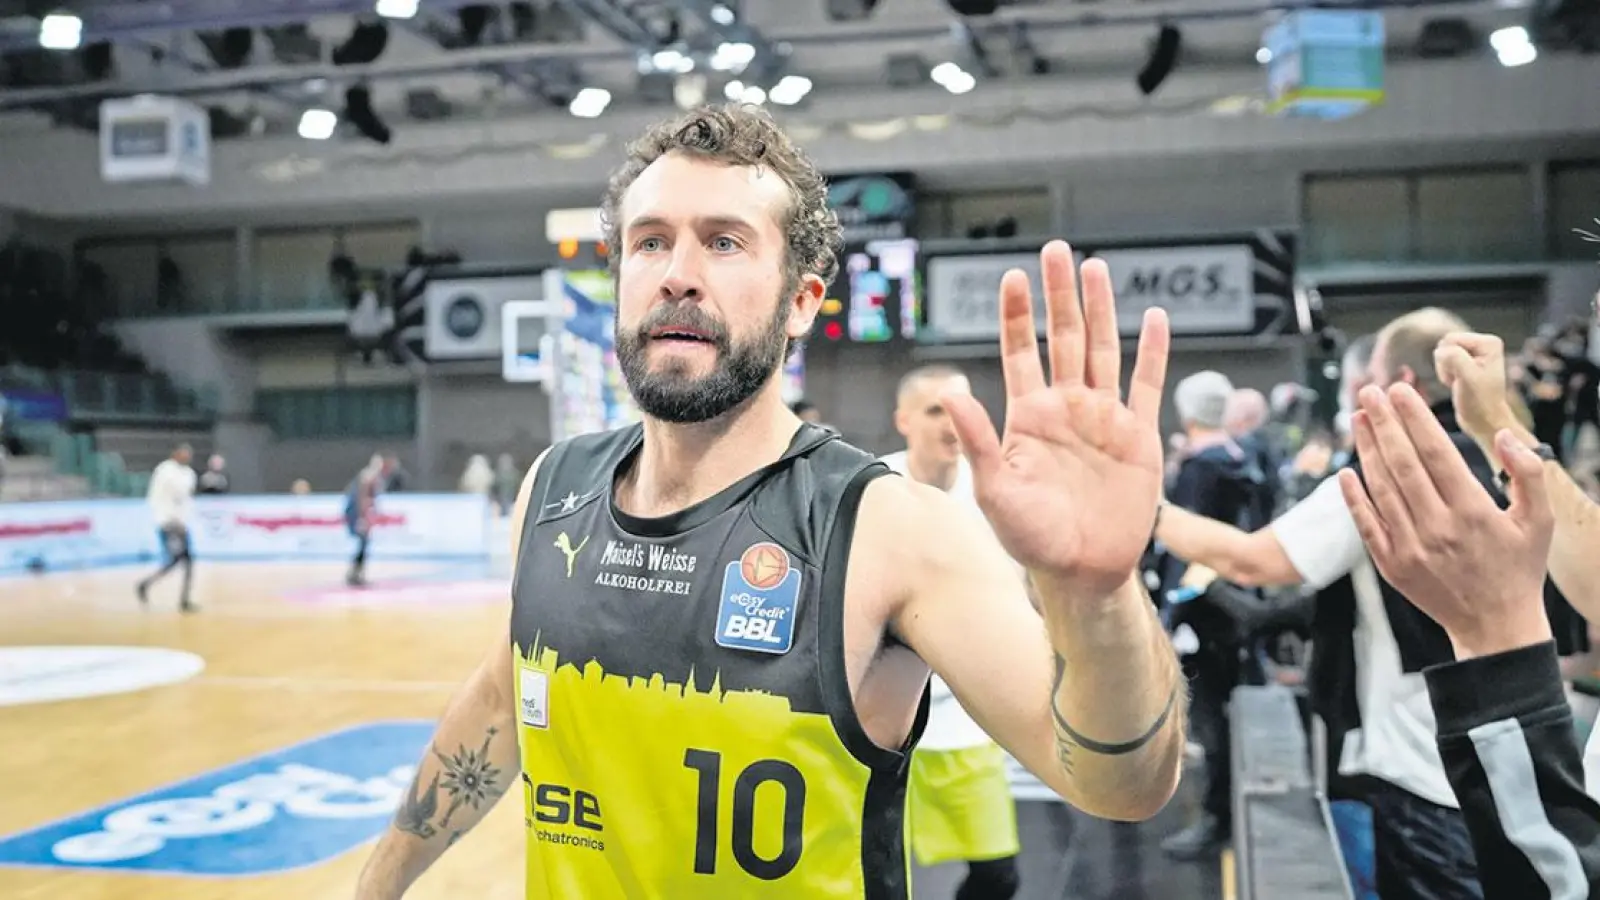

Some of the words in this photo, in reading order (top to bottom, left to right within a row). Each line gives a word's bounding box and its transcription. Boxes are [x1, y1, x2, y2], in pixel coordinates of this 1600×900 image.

[600, 540, 645, 568] Maisel's
[647, 544, 697, 573] Weisse
[595, 572, 692, 595] ALKOHOLFREI
[724, 615, 782, 643] BBL
[683, 747, 807, 881] 10
